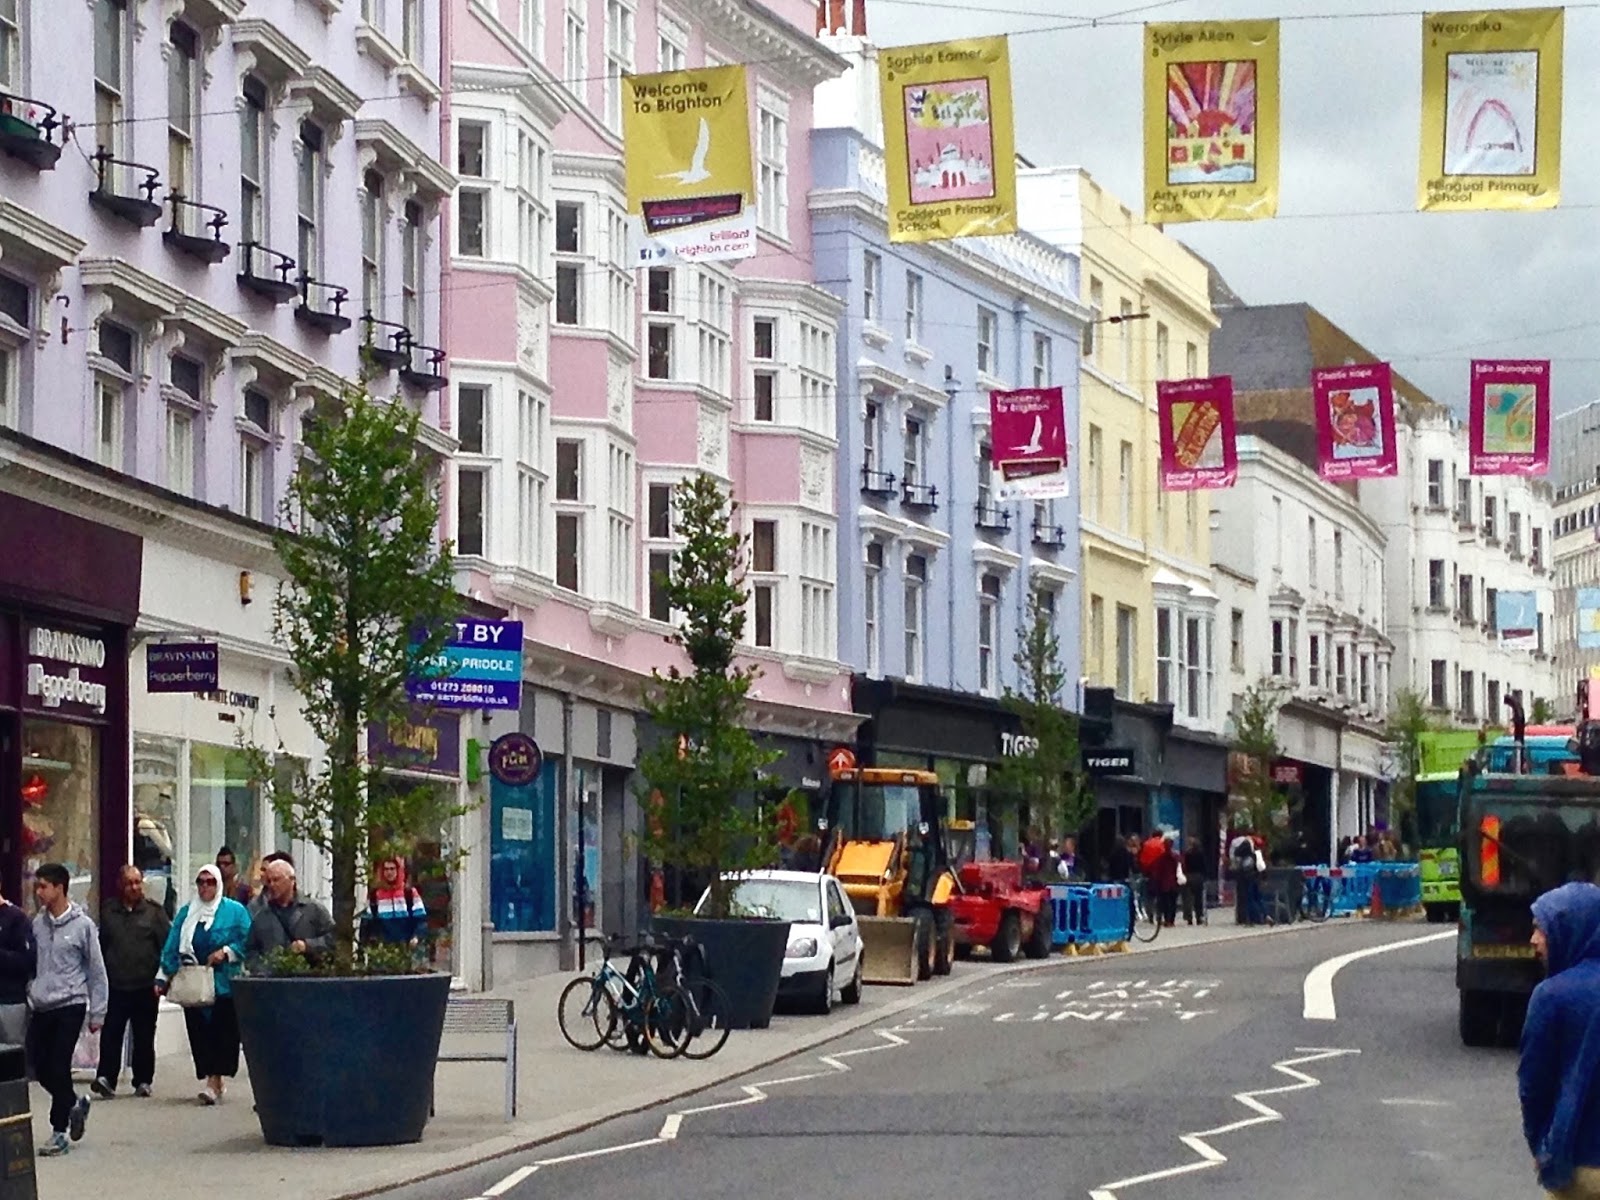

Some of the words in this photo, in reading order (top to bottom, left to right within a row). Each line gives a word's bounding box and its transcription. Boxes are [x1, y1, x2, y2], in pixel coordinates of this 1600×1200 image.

[1153, 31, 1193, 45] Sylvie
[887, 53, 933, 68] Sophie
[633, 81, 708, 98] Welcome
[634, 101, 651, 113] To
[656, 96, 722, 113] Brighton
[1153, 190, 1178, 201] Arty
[1218, 187, 1237, 197] Art
[1488, 181, 1540, 194] Primary
[1427, 192, 1472, 203] School
[896, 206, 951, 221] Coldean
[955, 203, 1003, 216] Primary
[1153, 202, 1183, 213] Club
[898, 219, 941, 232] School
[710, 229, 750, 241] brilliant
[473, 624, 504, 644] BY
[29, 627, 106, 669] BRAVISSIMO
[149, 651, 216, 662] BRAVISSIMO
[462, 657, 514, 672] PRIDDLE
[149, 664, 216, 684] Pepperberry
[28, 663, 107, 715] Pepperberry
[431, 681, 459, 691] 01273
[1087, 758, 1130, 767] TIGER
